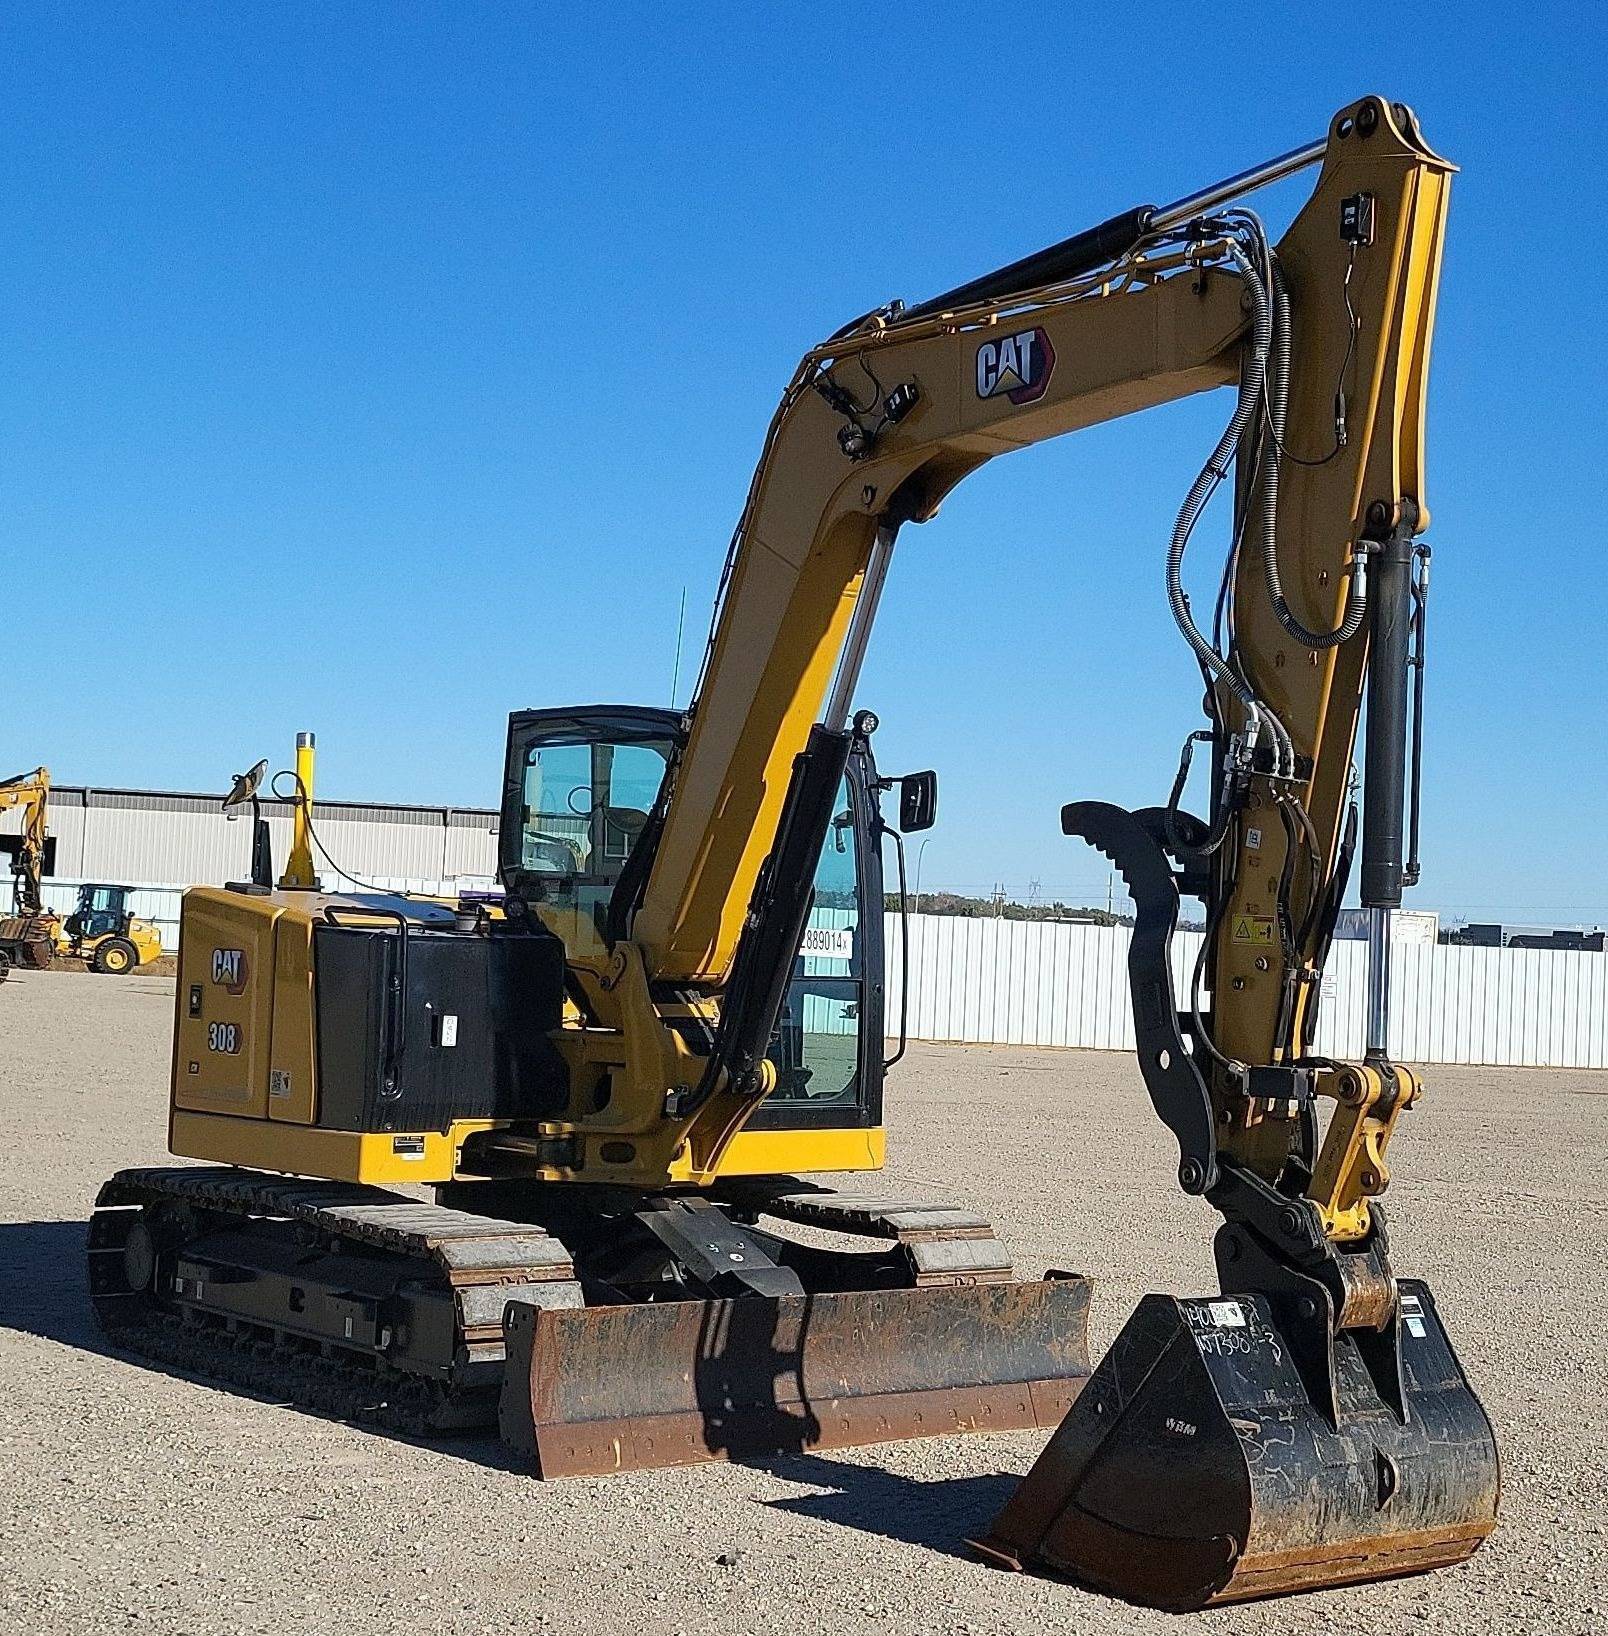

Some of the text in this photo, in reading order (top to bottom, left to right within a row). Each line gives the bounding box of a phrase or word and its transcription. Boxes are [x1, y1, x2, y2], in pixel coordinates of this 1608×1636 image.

[977, 330, 1036, 398] CAT
[212, 949, 241, 984] CAT
[208, 1022, 236, 1053] 308
